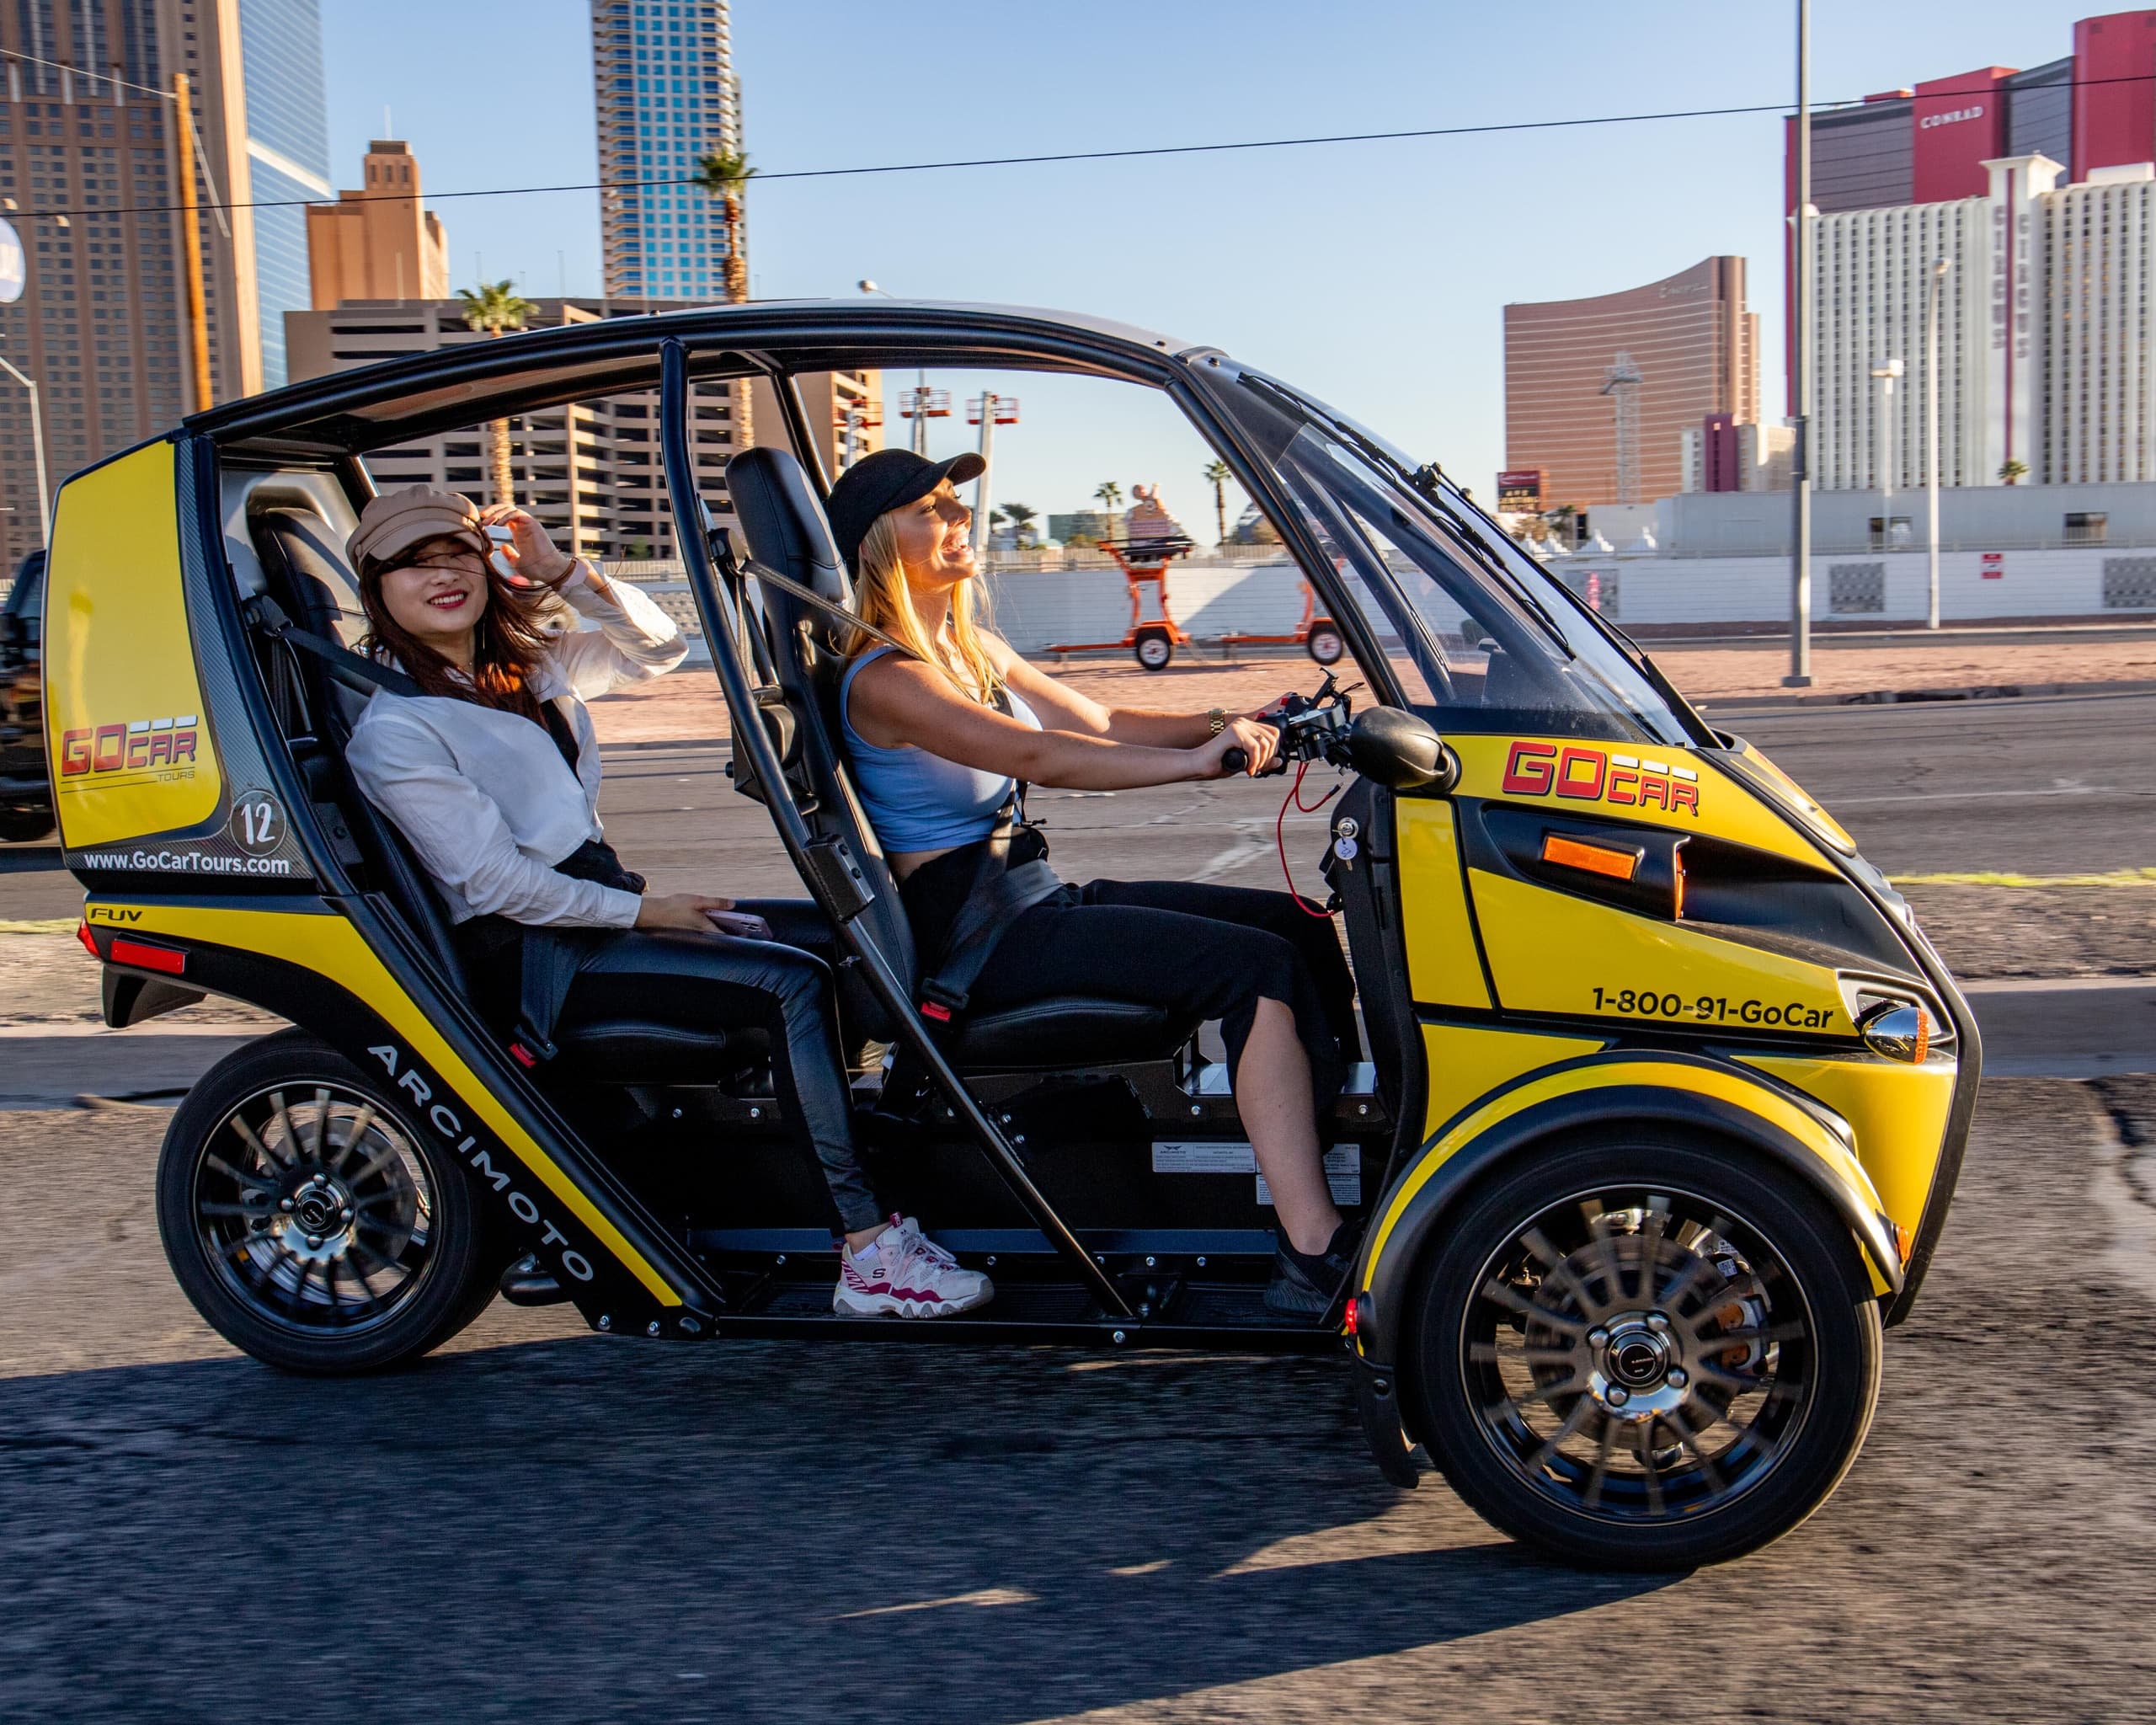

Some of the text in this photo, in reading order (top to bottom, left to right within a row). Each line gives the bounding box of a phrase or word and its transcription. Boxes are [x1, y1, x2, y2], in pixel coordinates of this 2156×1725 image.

[157, 770, 195, 782] TOURS
[241, 802, 275, 845] 12
[84, 851, 290, 874] www.GoCarTours.com
[90, 908, 143, 921] FUV
[1593, 986, 1834, 1028] 1-800-91-GoCar
[367, 1044, 594, 1281] ARCIMOTO
